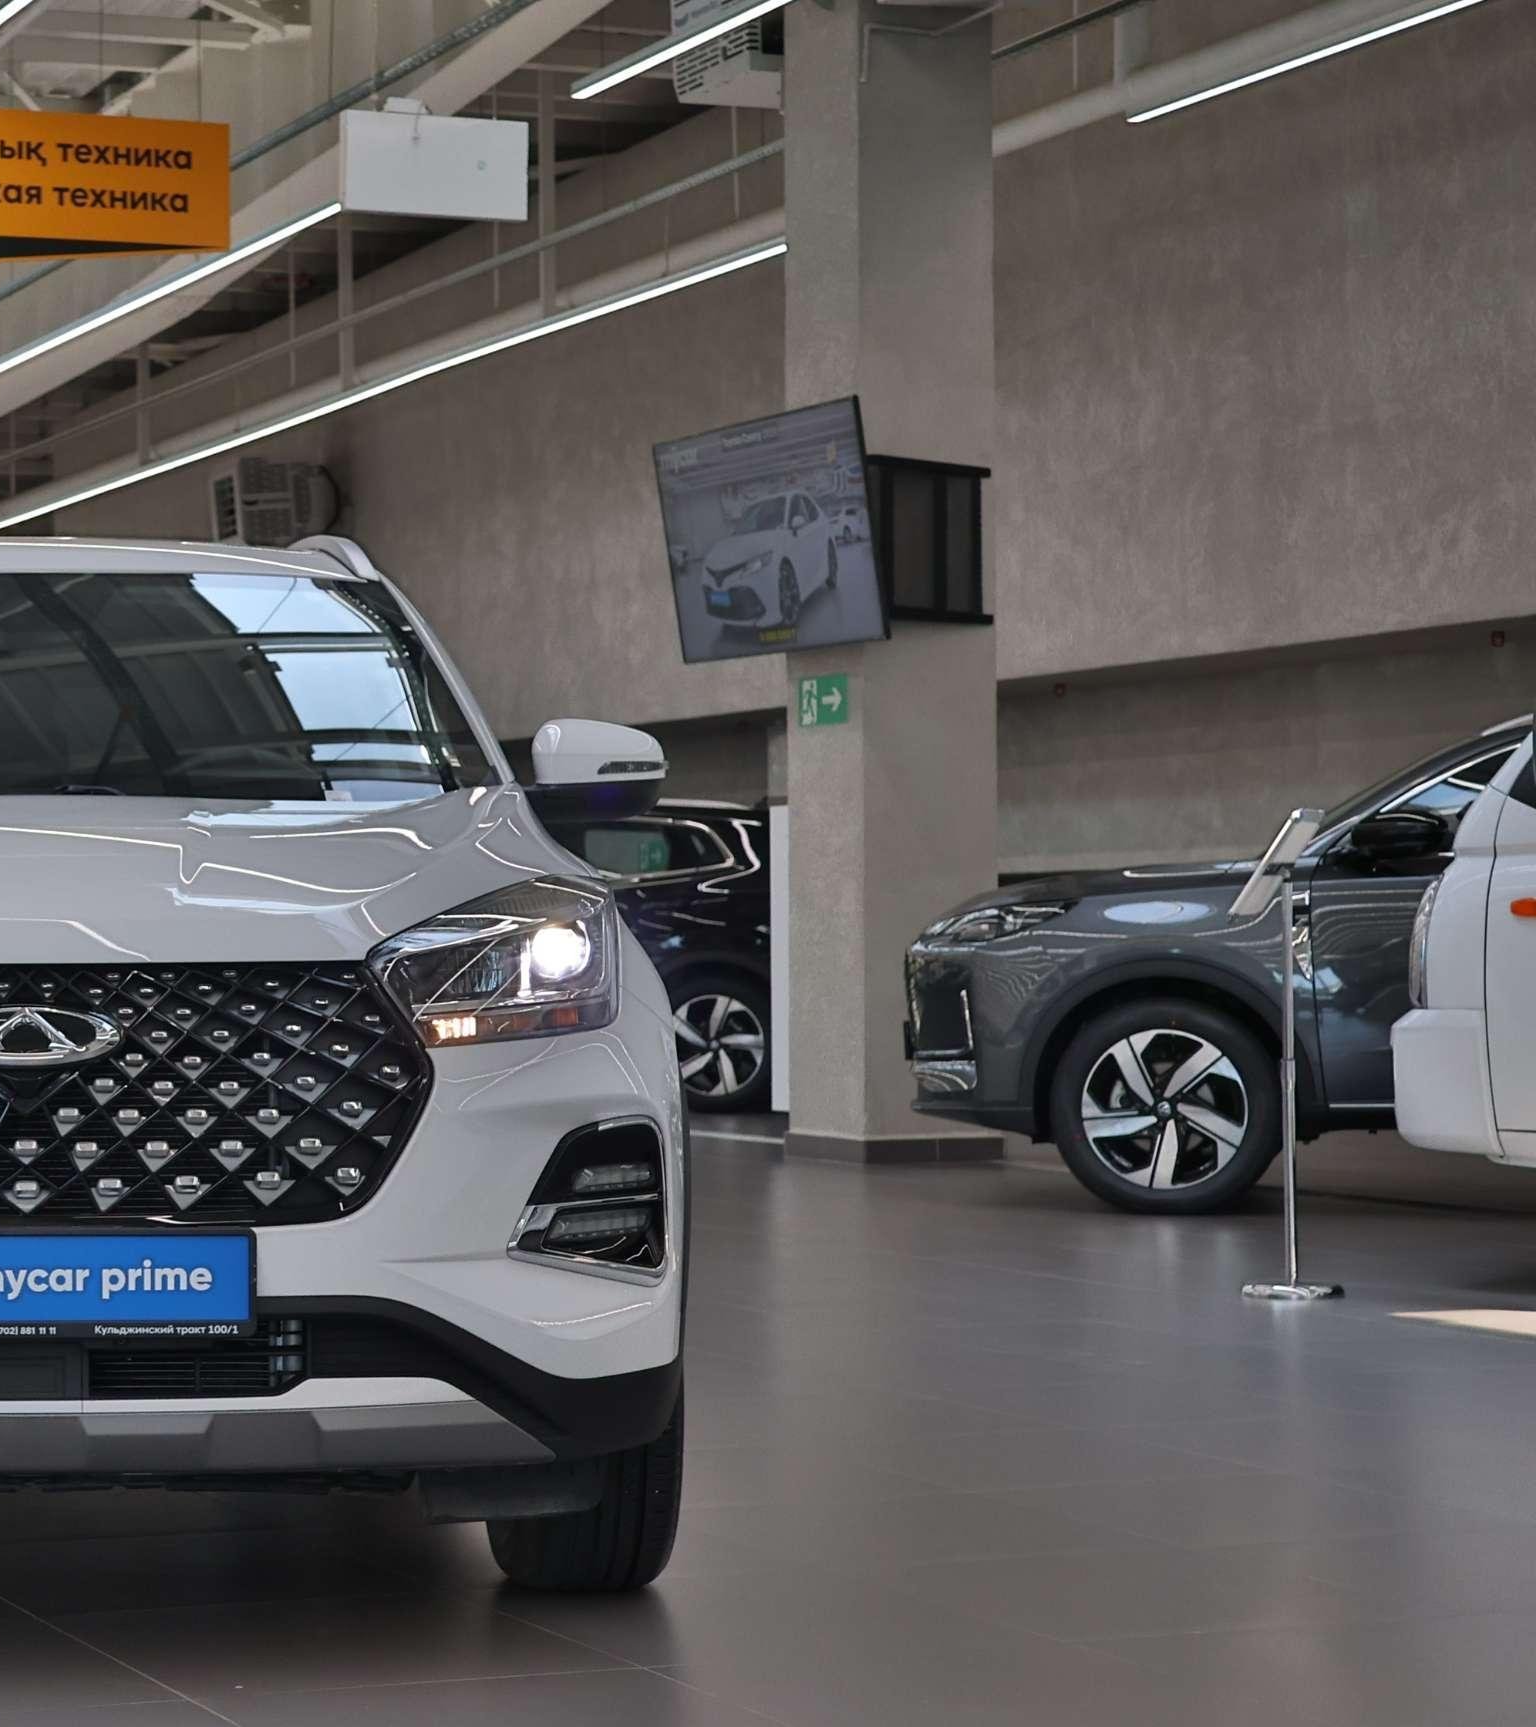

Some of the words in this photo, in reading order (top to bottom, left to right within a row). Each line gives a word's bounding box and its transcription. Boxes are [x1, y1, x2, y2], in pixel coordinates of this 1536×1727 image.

[56, 143, 193, 170] техника
[53, 186, 190, 213] техника
[101, 1259, 213, 1300] prime
[38, 1326, 47, 1335] 11
[48, 1326, 57, 1335] 11
[94, 1324, 174, 1336] Кульджинский
[175, 1326, 207, 1336] тракт
[208, 1324, 239, 1335] 100/1
